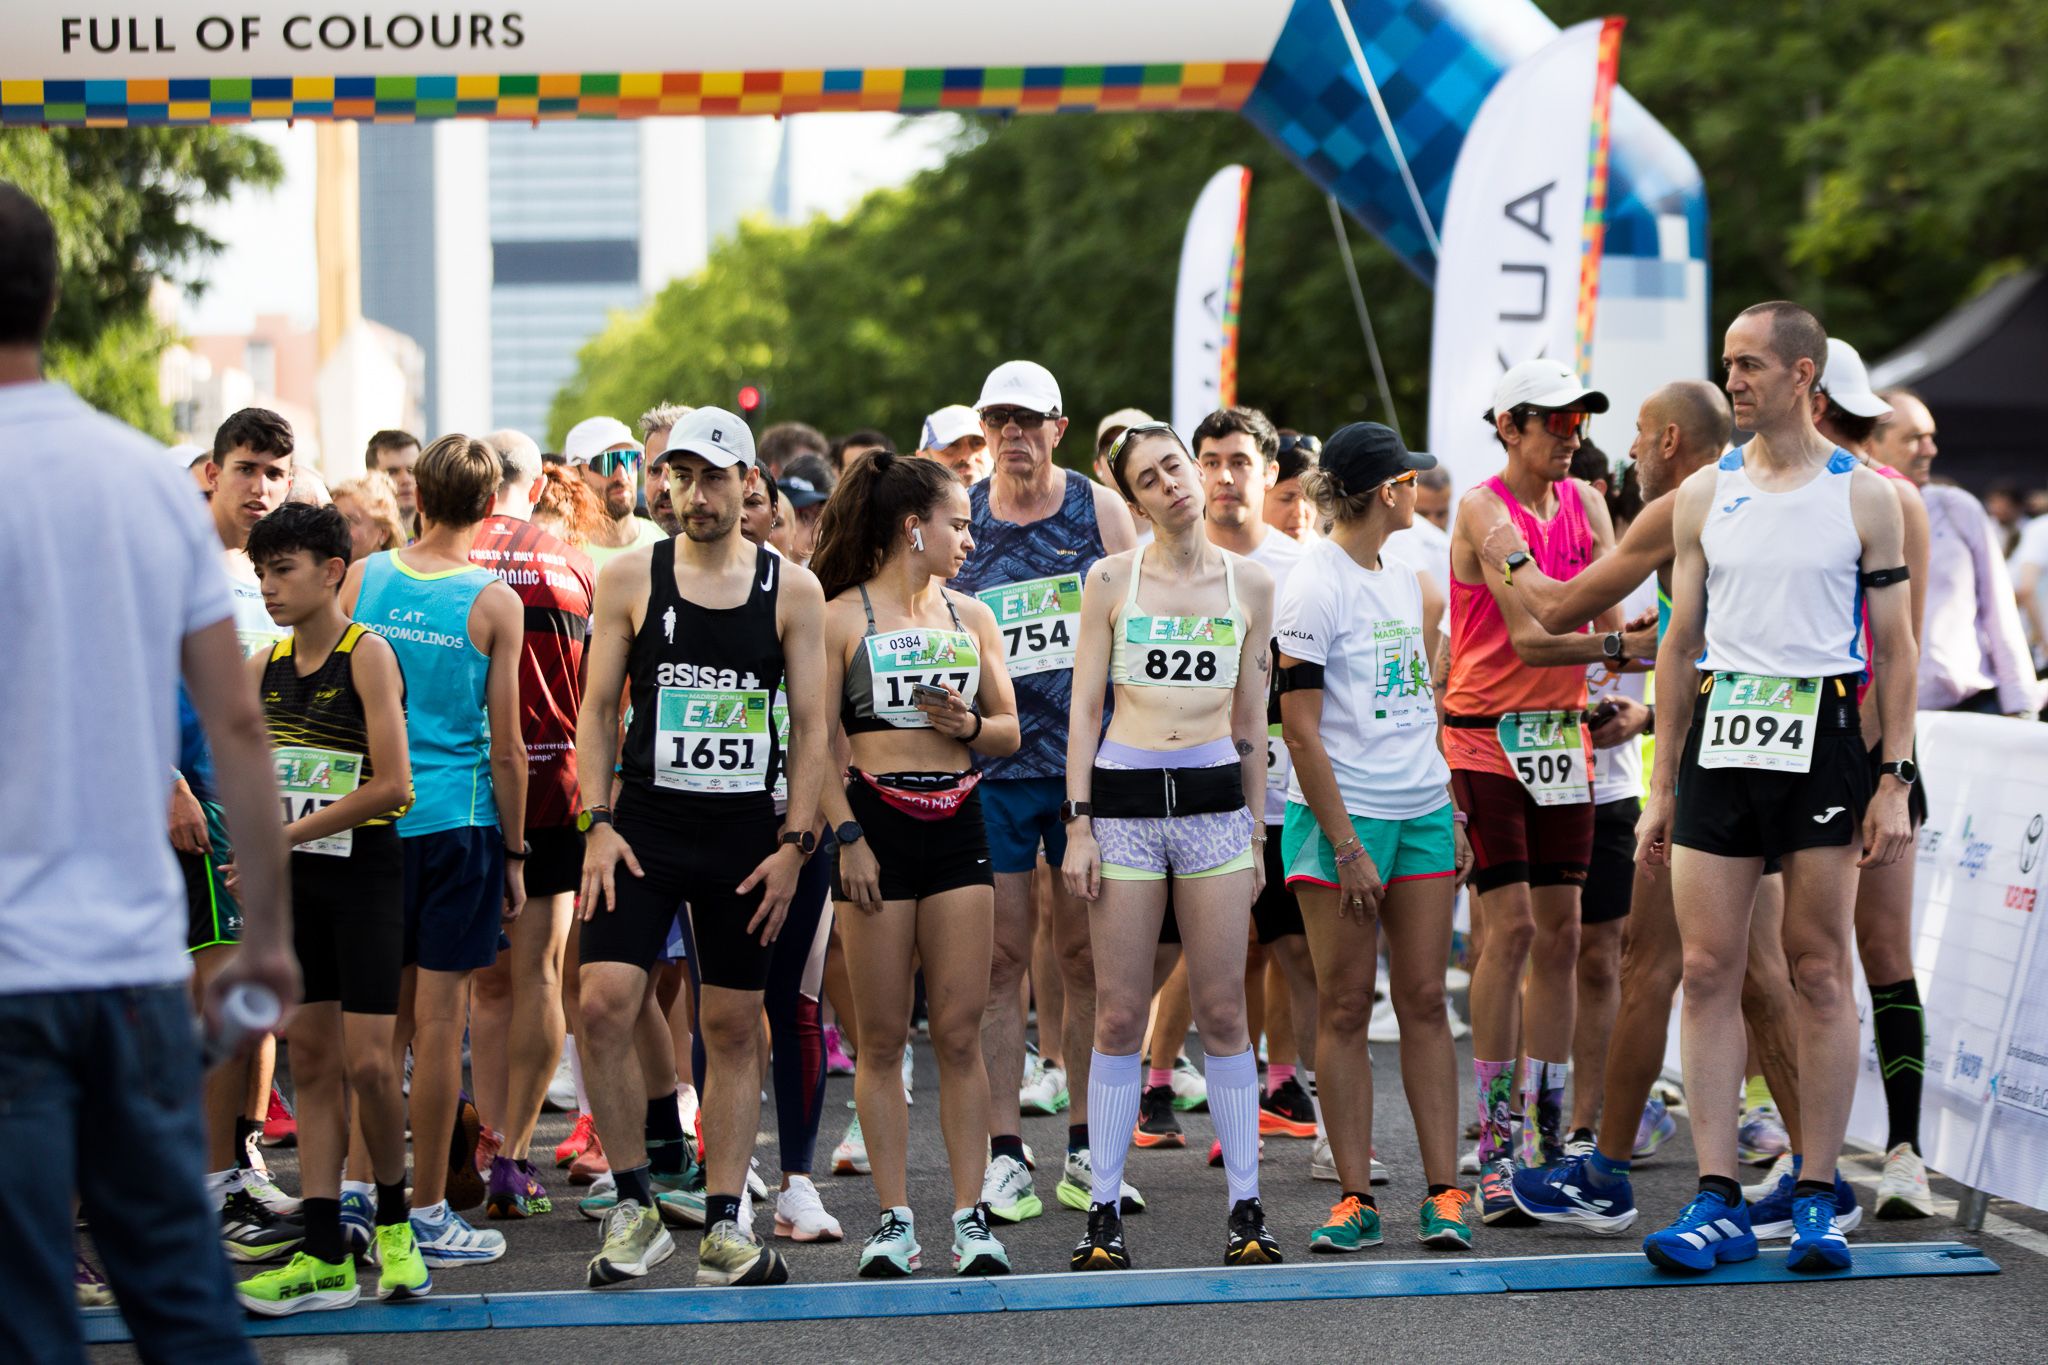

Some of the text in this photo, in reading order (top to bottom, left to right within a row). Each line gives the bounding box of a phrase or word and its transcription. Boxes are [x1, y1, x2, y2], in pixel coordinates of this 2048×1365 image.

[61, 13, 526, 54] FULL OF COLOURS
[1002, 588, 1061, 621] ELA
[889, 635, 921, 651] 0384
[1003, 619, 1071, 657] 754
[1149, 616, 1215, 641] ELA
[1145, 649, 1217, 681] 828
[1728, 679, 1793, 709] ELA
[683, 699, 748, 728] ELA
[1518, 722, 1566, 748] ELA
[1711, 714, 1804, 750] 1094
[671, 737, 756, 770] 1651
[275, 758, 332, 789] ELA
[1517, 754, 1573, 785] 509
